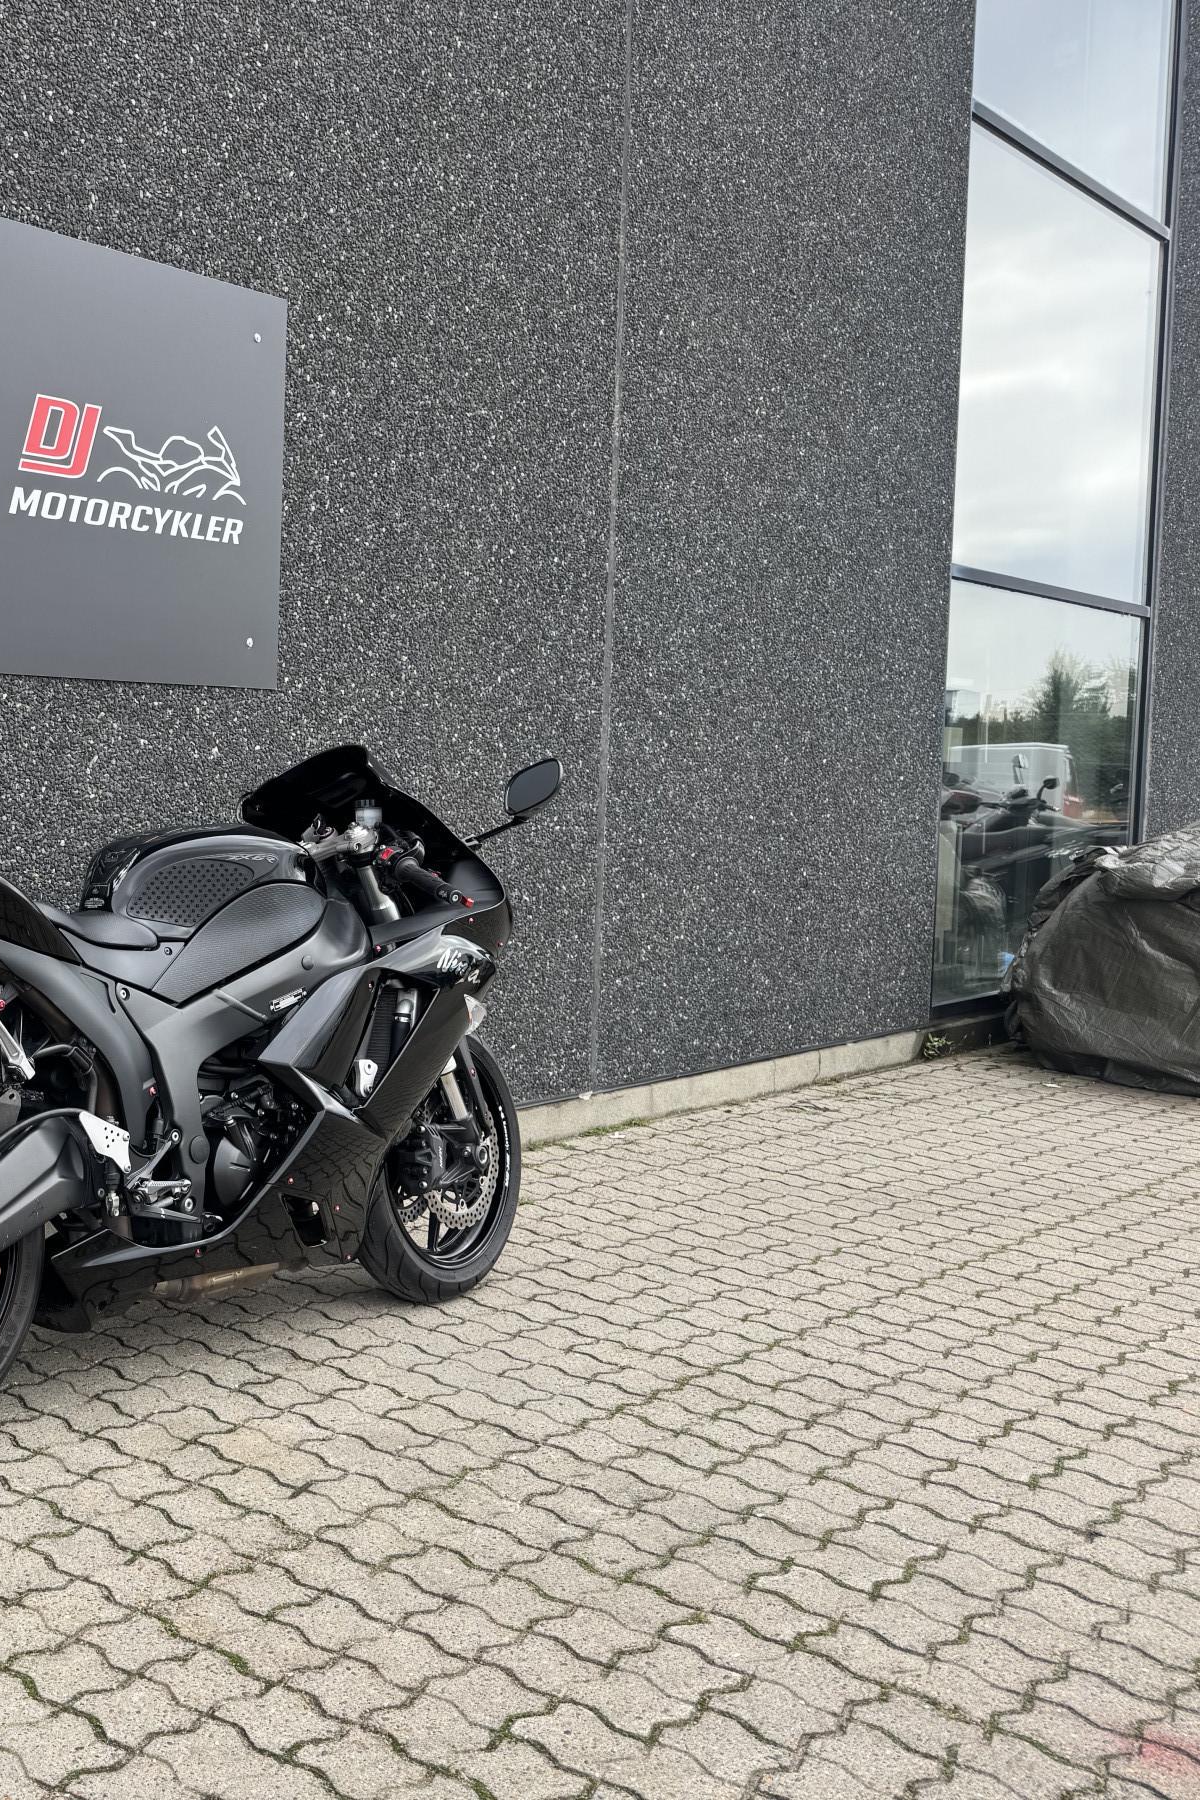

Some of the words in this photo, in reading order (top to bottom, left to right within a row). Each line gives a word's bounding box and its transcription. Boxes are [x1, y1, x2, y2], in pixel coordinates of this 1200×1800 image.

[18, 393, 102, 478] DJ
[8, 486, 244, 545] MOTORCYKLER
[436, 948, 481, 985] Ninja
